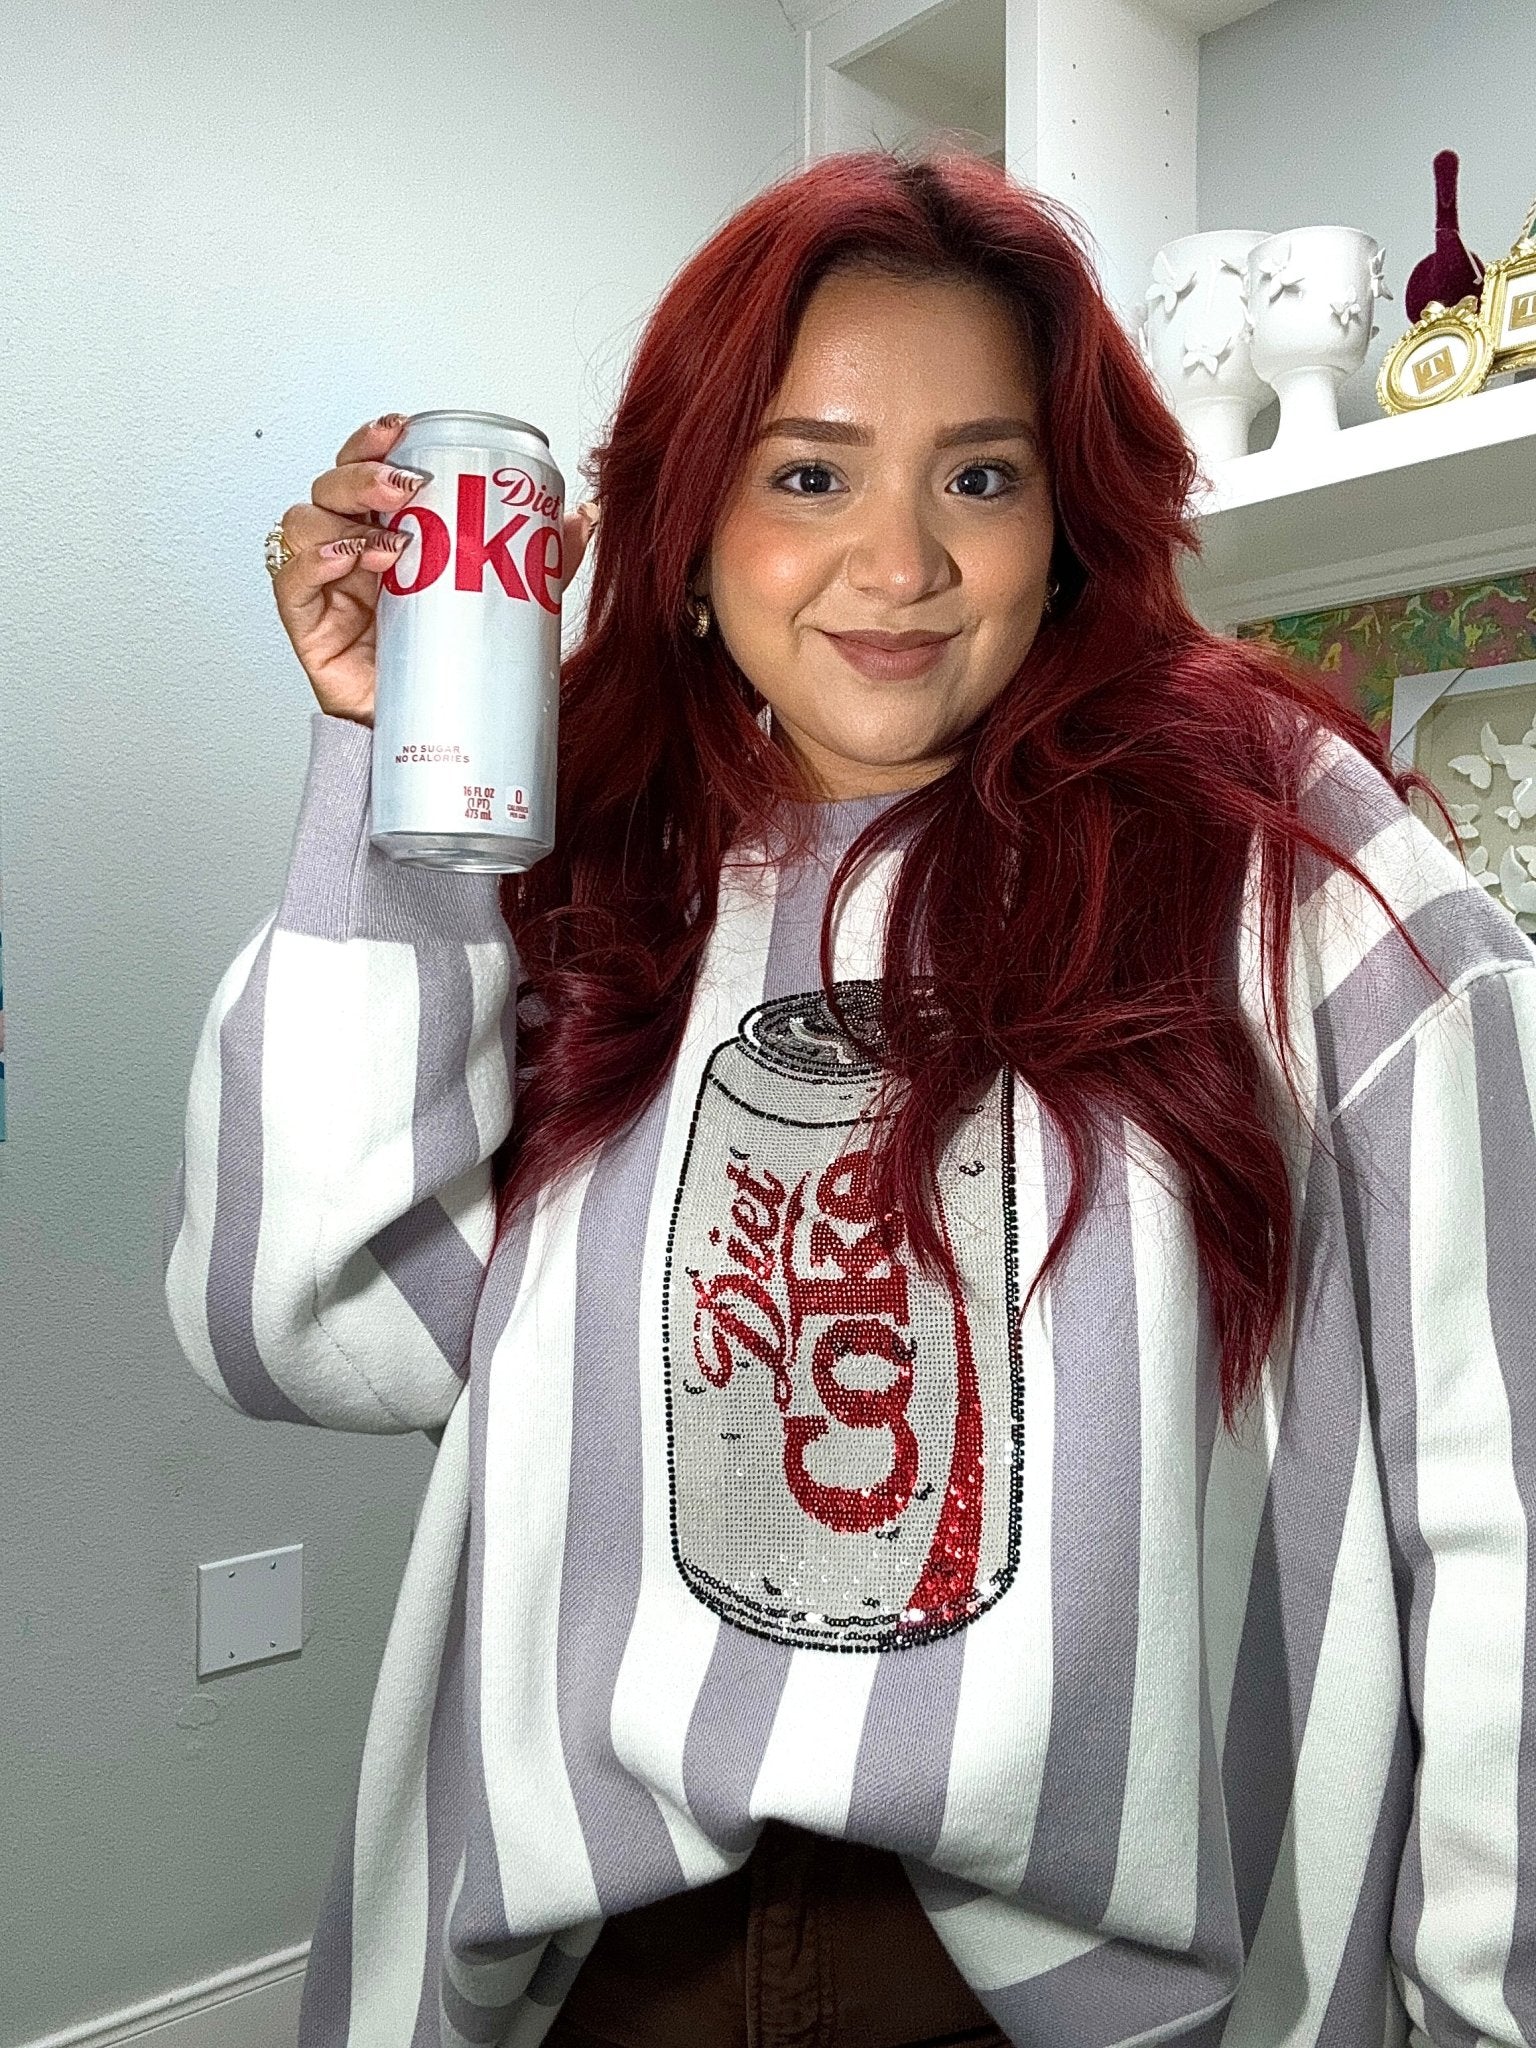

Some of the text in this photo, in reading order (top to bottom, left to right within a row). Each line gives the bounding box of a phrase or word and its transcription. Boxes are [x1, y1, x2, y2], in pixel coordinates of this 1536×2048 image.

[1420, 353, 1446, 383] T
[492, 467, 563, 521] Diet
[382, 474, 562, 615] oke
[402, 745, 460, 754] NO SUGAR
[395, 754, 470, 763] NO CALORIES
[463, 786, 495, 798] 16 FL OZ
[515, 789, 523, 805] 0
[465, 808, 479, 819] 473
[695, 1162, 808, 1416] Diet
